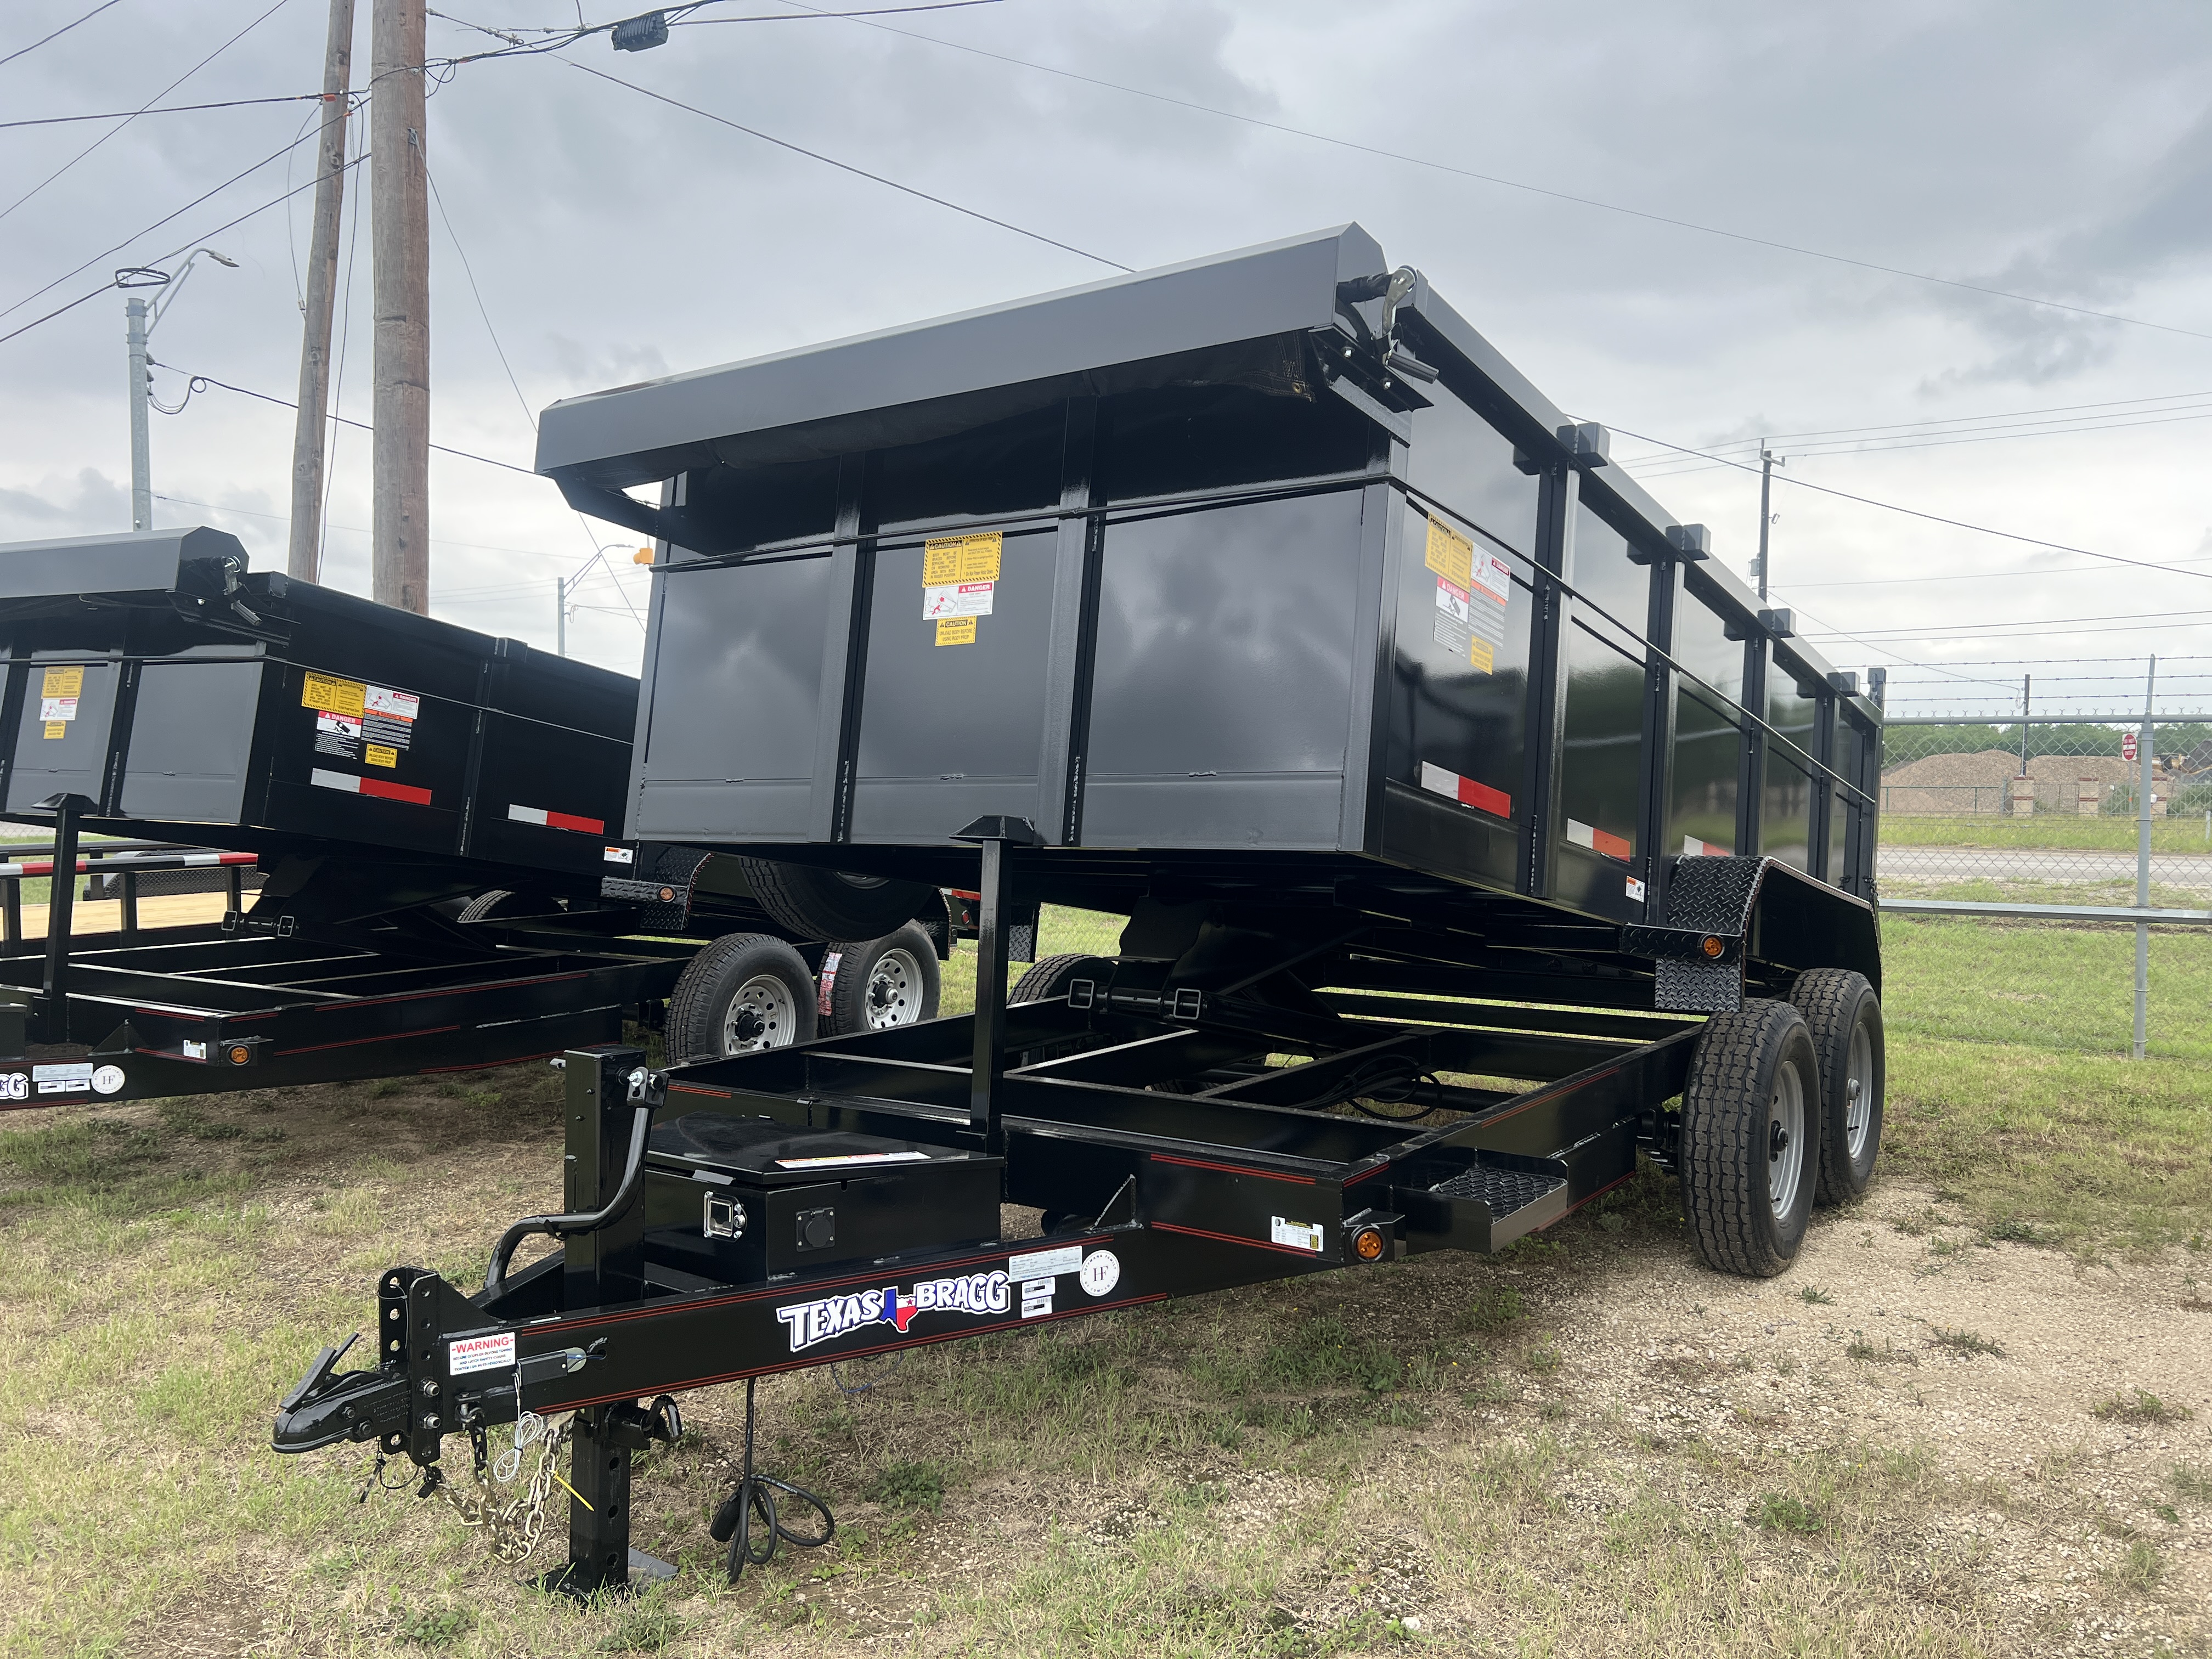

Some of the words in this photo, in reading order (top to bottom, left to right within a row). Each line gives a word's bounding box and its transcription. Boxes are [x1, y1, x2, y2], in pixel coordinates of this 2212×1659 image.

[1497, 562, 1508, 574] DANGER
[1447, 584, 1464, 600] DANGER
[332, 714, 356, 723] DANGER
[103, 1075, 115, 1085] HF
[1105, 1255, 1116, 1269] FAMILY
[1093, 1266, 1108, 1282] HF
[1091, 1277, 1115, 1292] COMPANIES
[778, 1292, 884, 1350] TEXAS
[915, 1272, 1009, 1312] BRAGG
